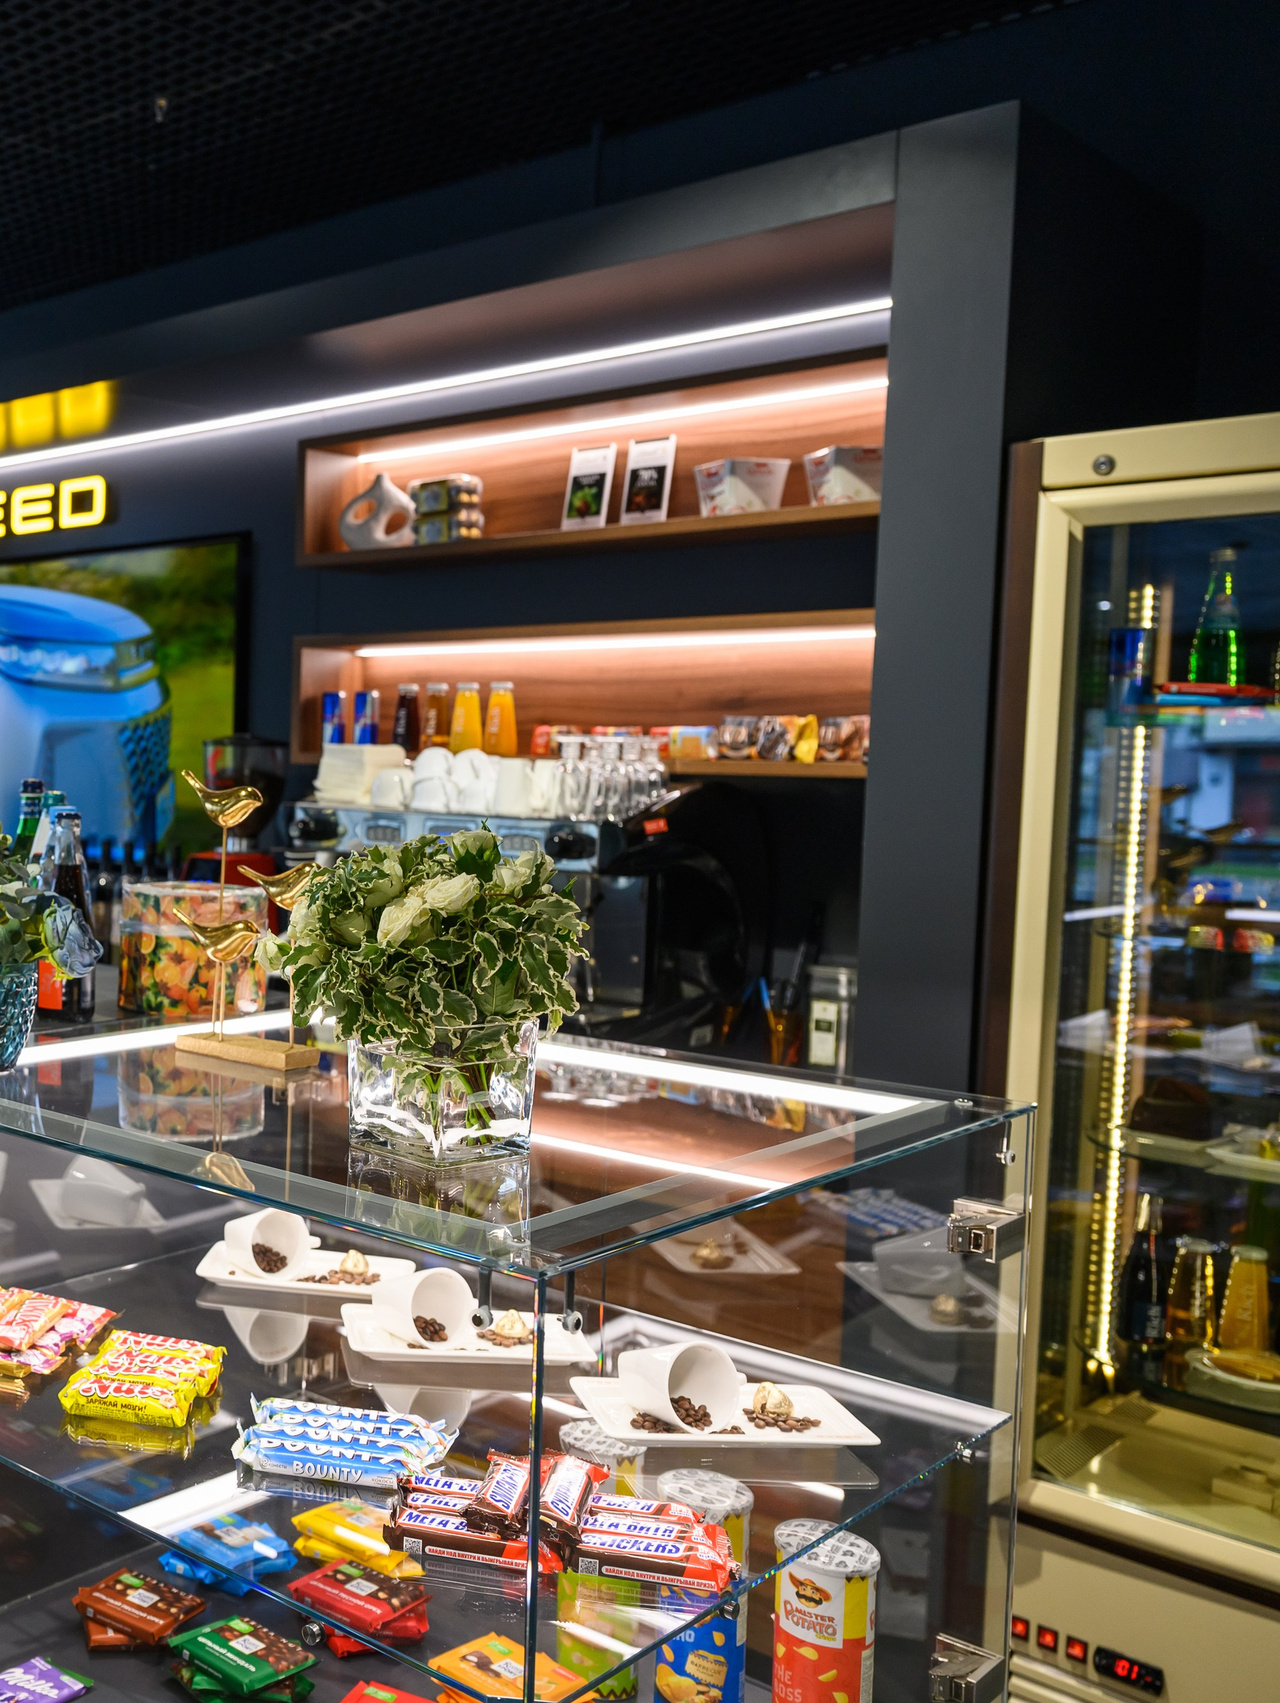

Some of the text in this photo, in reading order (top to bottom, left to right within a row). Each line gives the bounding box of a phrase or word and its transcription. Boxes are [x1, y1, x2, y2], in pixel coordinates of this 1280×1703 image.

[78, 1378, 176, 1399] Nuts
[85, 1398, 147, 1413] ЗАРЯЖАЙ МОЗГИ!
[292, 1460, 364, 1484] BOUNTY
[582, 1533, 681, 1555] SNICKERS
[428, 1547, 445, 1556] НАЙДИ
[446, 1550, 457, 1558] КОД
[458, 1551, 476, 1561] ВНУТРИ
[481, 1556, 513, 1567] ВЫИГРЫВАЙ
[605, 1567, 621, 1576] НАЙДИ
[623, 1569, 633, 1577] КОД
[635, 1571, 655, 1580] ВНУТРИ
[661, 1575, 695, 1587] ВЫИГРЫВАЙ
[697, 1580, 716, 1590] ПРИЗЫ
[783, 1599, 838, 1637] POTATO
[795, 1606, 836, 1624] MISTER
[775, 1661, 792, 1685] THE
